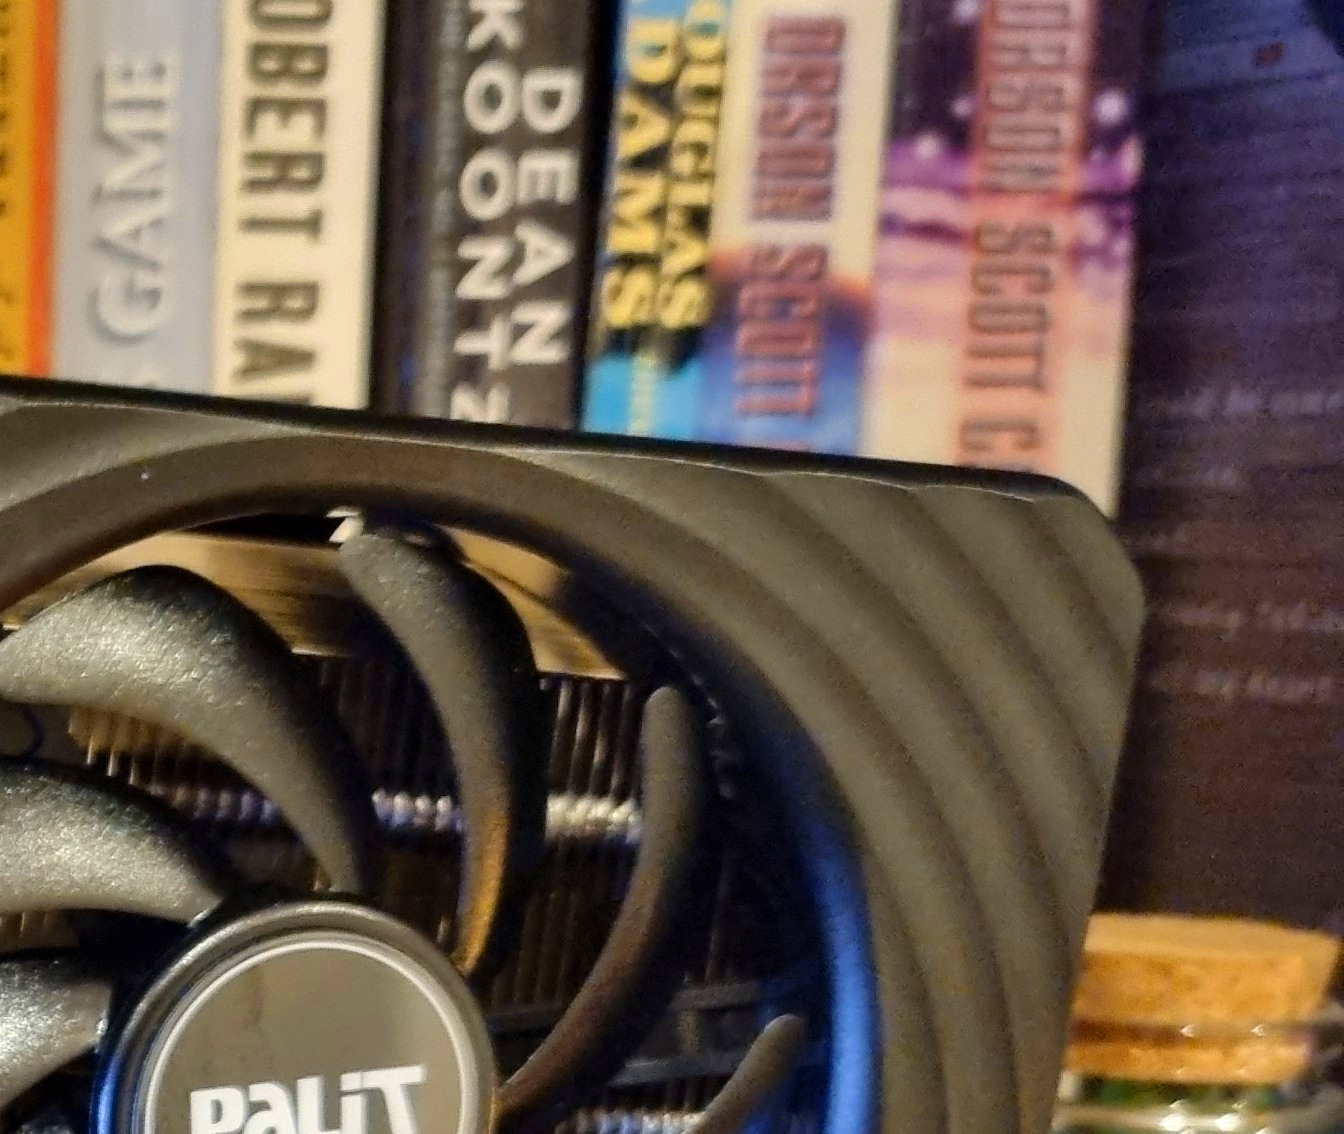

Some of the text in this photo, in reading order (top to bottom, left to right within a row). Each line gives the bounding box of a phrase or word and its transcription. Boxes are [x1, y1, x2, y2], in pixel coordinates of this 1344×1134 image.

[88, 50, 176, 348] GAME
[512, 66, 582, 364] DEAN
[965, 222, 1054, 389] SCOTT
[231, 281, 320, 400] RA
